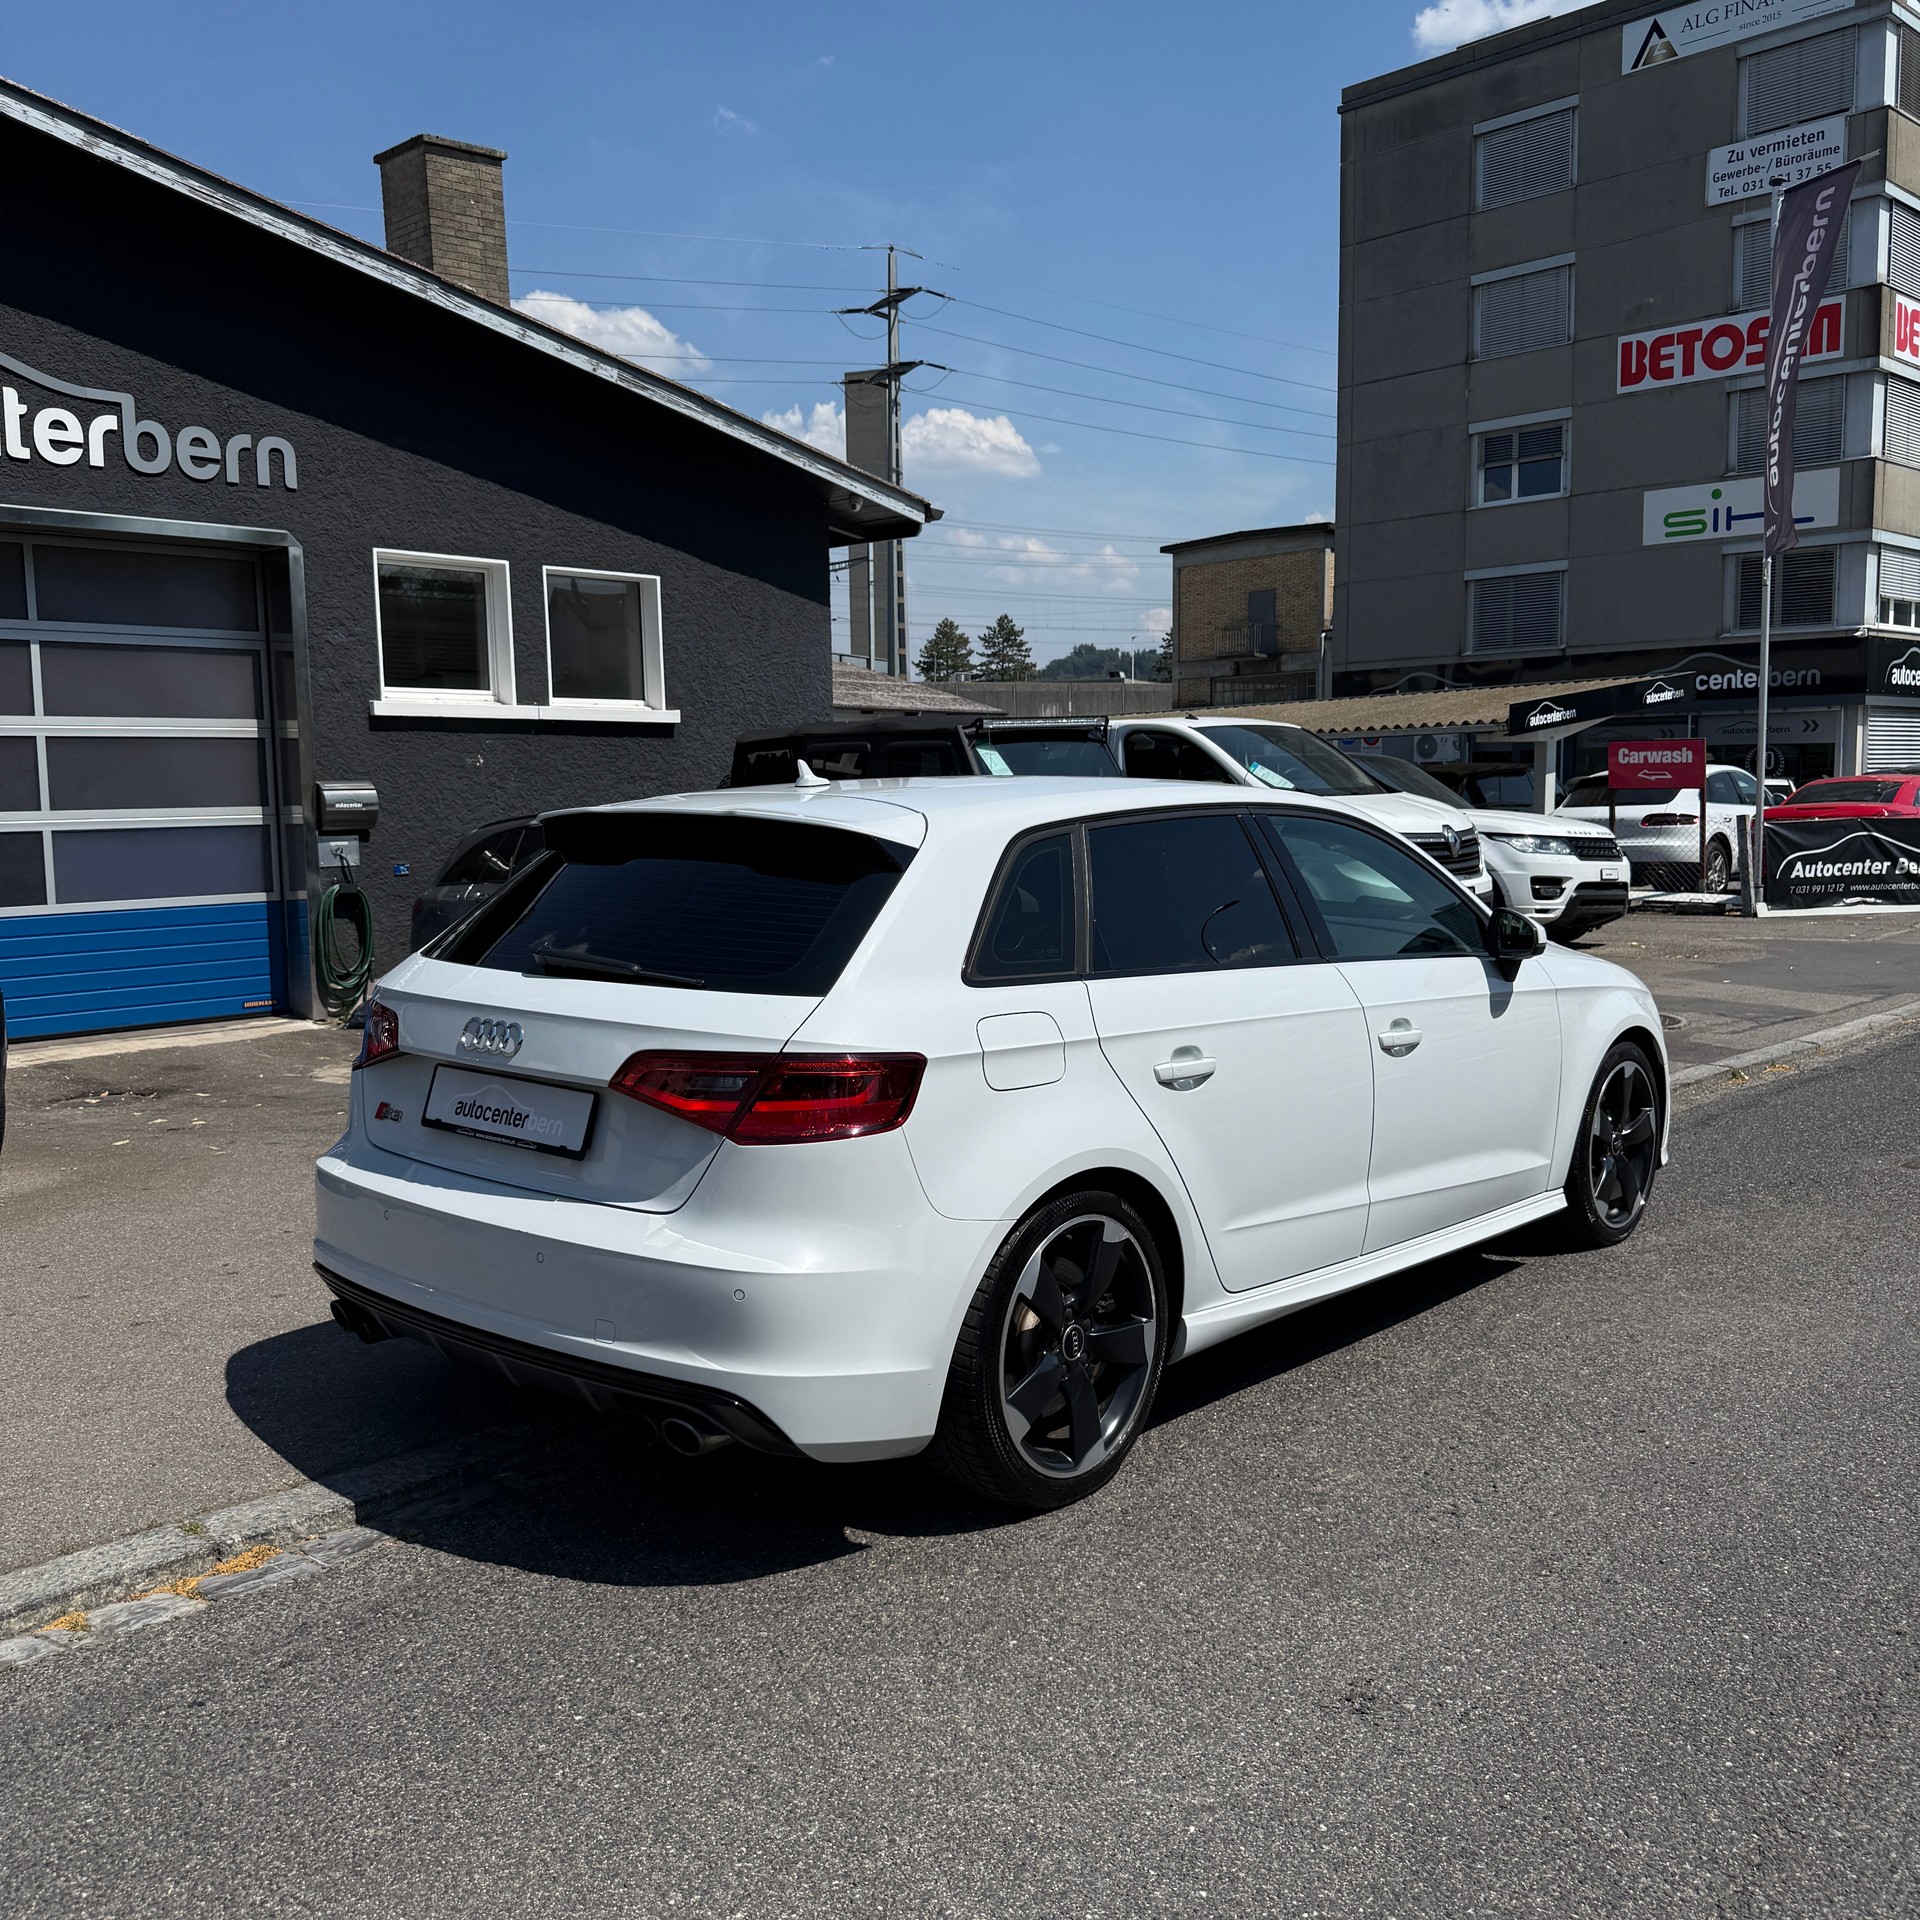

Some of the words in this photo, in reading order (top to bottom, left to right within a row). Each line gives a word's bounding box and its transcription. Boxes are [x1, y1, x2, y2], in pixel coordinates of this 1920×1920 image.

[1681, 8, 1719, 33] ALG
[1738, 17, 1761, 31] since
[1762, 11, 1782, 25] 2015
[1727, 149, 1744, 164] Zu
[1750, 129, 1825, 158] vermieten
[1775, 145, 1840, 169] Büroräume
[1718, 184, 1738, 198] Tel.
[1742, 179, 1764, 193] 031
[1796, 167, 1812, 181] 37
[1816, 162, 1832, 175] 55
[1620, 302, 1842, 387] BETOSN
[1769, 183, 1836, 488] autocenterbern
[0, 387, 297, 489] terbern
[1646, 688, 1684, 704] autocenterbern
[1529, 708, 1576, 727] autocenterbern
[1618, 747, 1693, 764] Carwash
[1790, 859, 1891, 879] Autocenter
[1895, 857, 1920, 875] Be
[1796, 885, 1810, 894] 031
[1811, 885, 1825, 893] 991
[455, 1099, 563, 1137] autocenterbern
